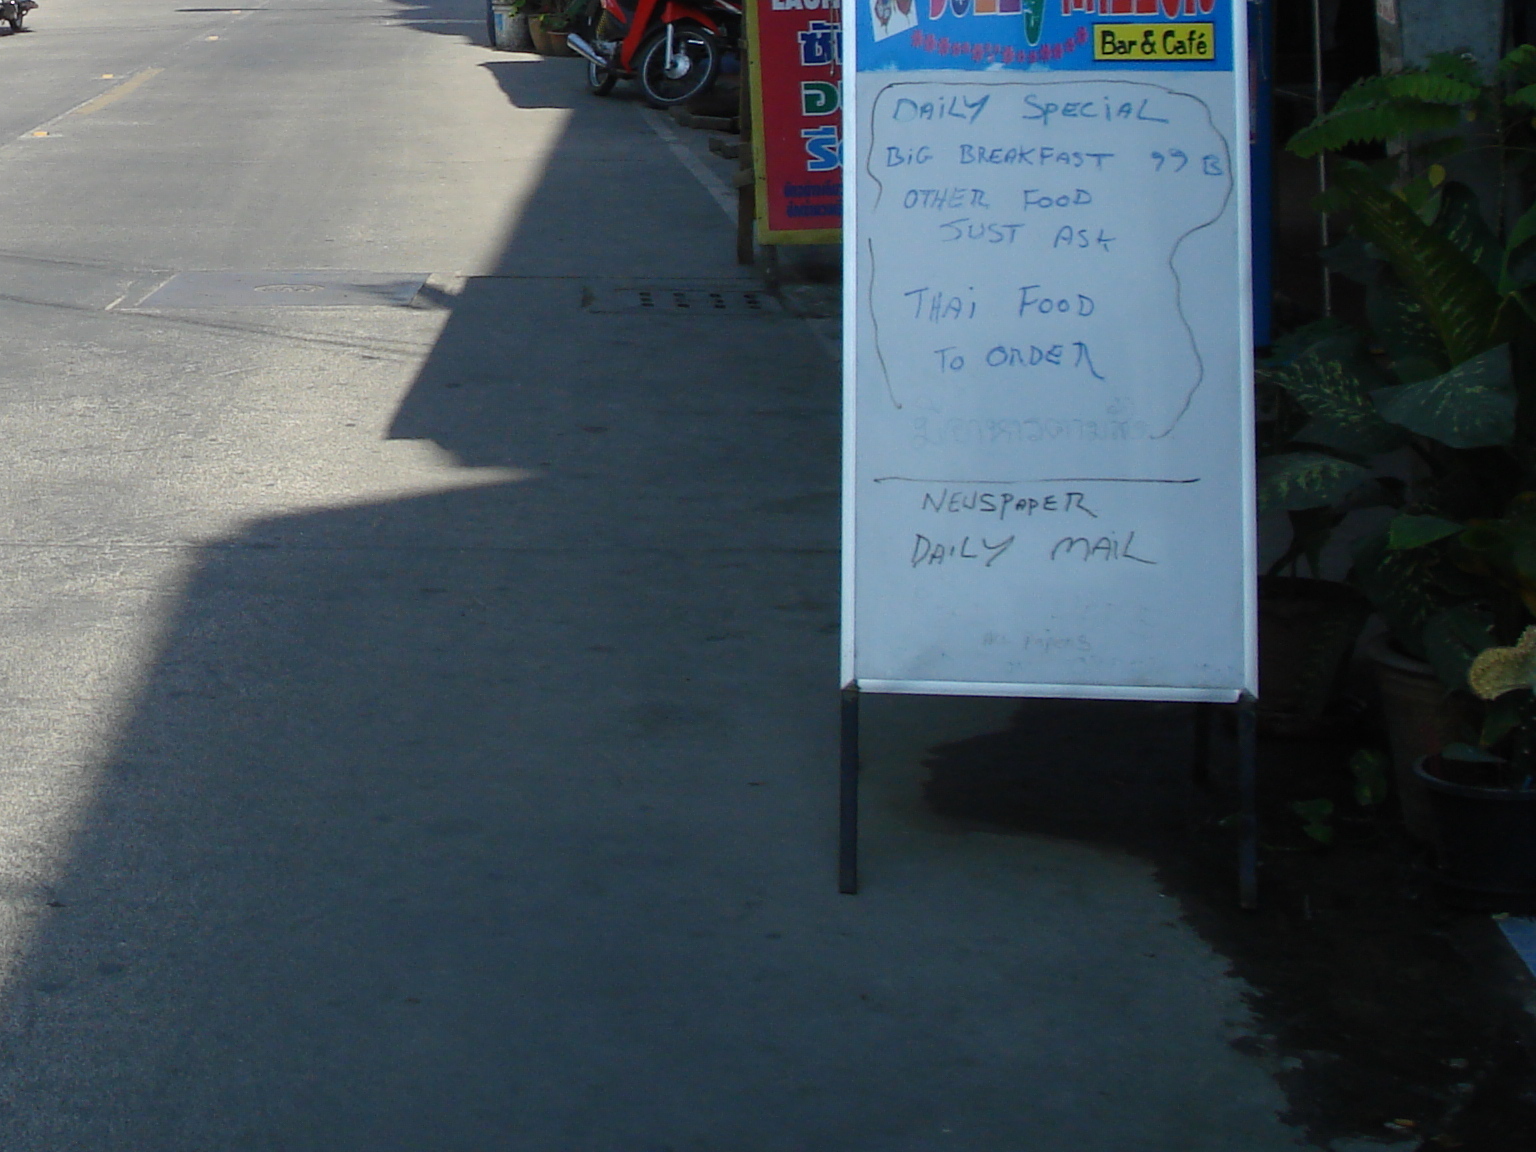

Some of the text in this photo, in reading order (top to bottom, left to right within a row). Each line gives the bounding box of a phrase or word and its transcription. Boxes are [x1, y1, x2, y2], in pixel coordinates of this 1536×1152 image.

[1101, 29, 1208, 56] Bar & Café
[959, 145, 1115, 168] BREAKFAST
[903, 188, 990, 210] OTHER
[940, 217, 1027, 245] JUST
